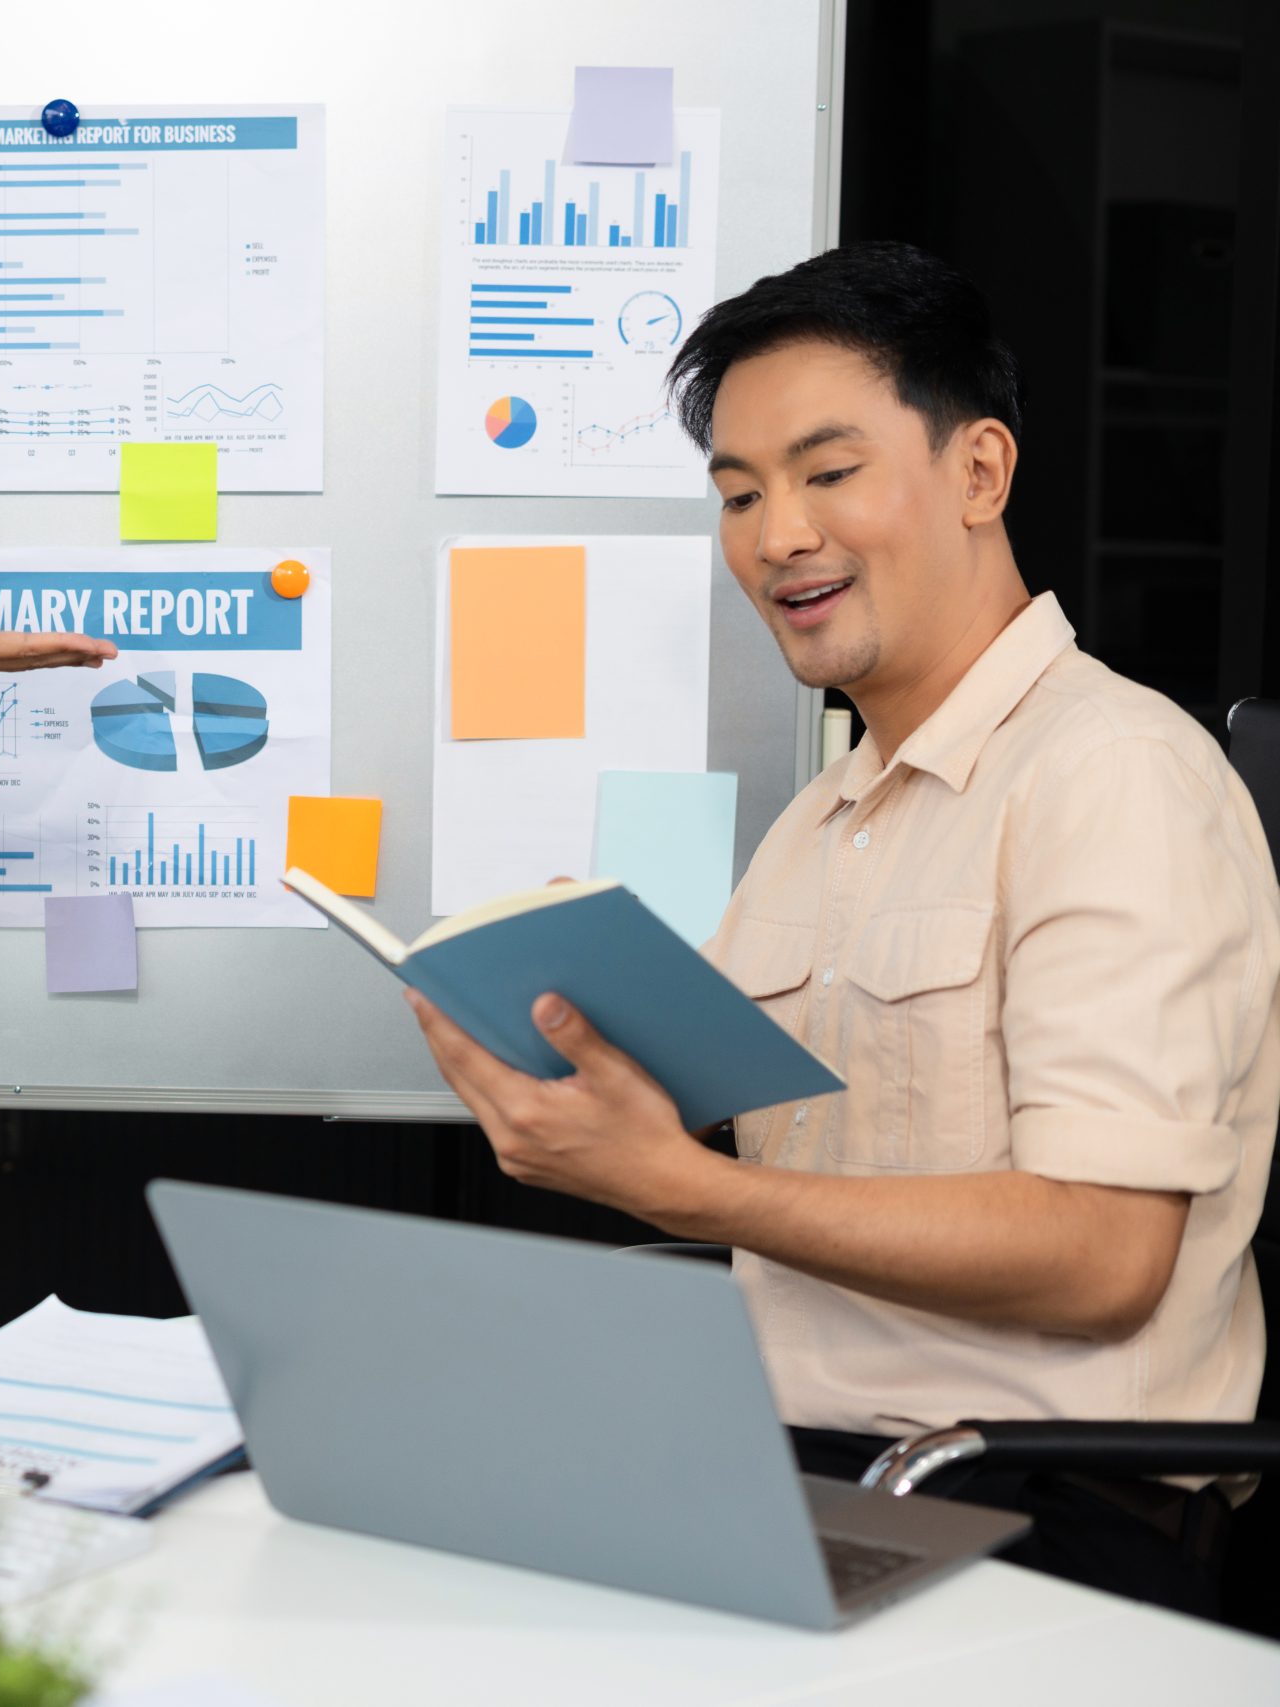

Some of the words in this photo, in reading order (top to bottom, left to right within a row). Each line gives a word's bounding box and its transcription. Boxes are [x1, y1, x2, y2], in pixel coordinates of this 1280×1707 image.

[76, 126, 130, 145] REPORT
[133, 126, 162, 144] FOR
[164, 124, 237, 144] BUSINESS
[104, 588, 254, 636] REPORT
